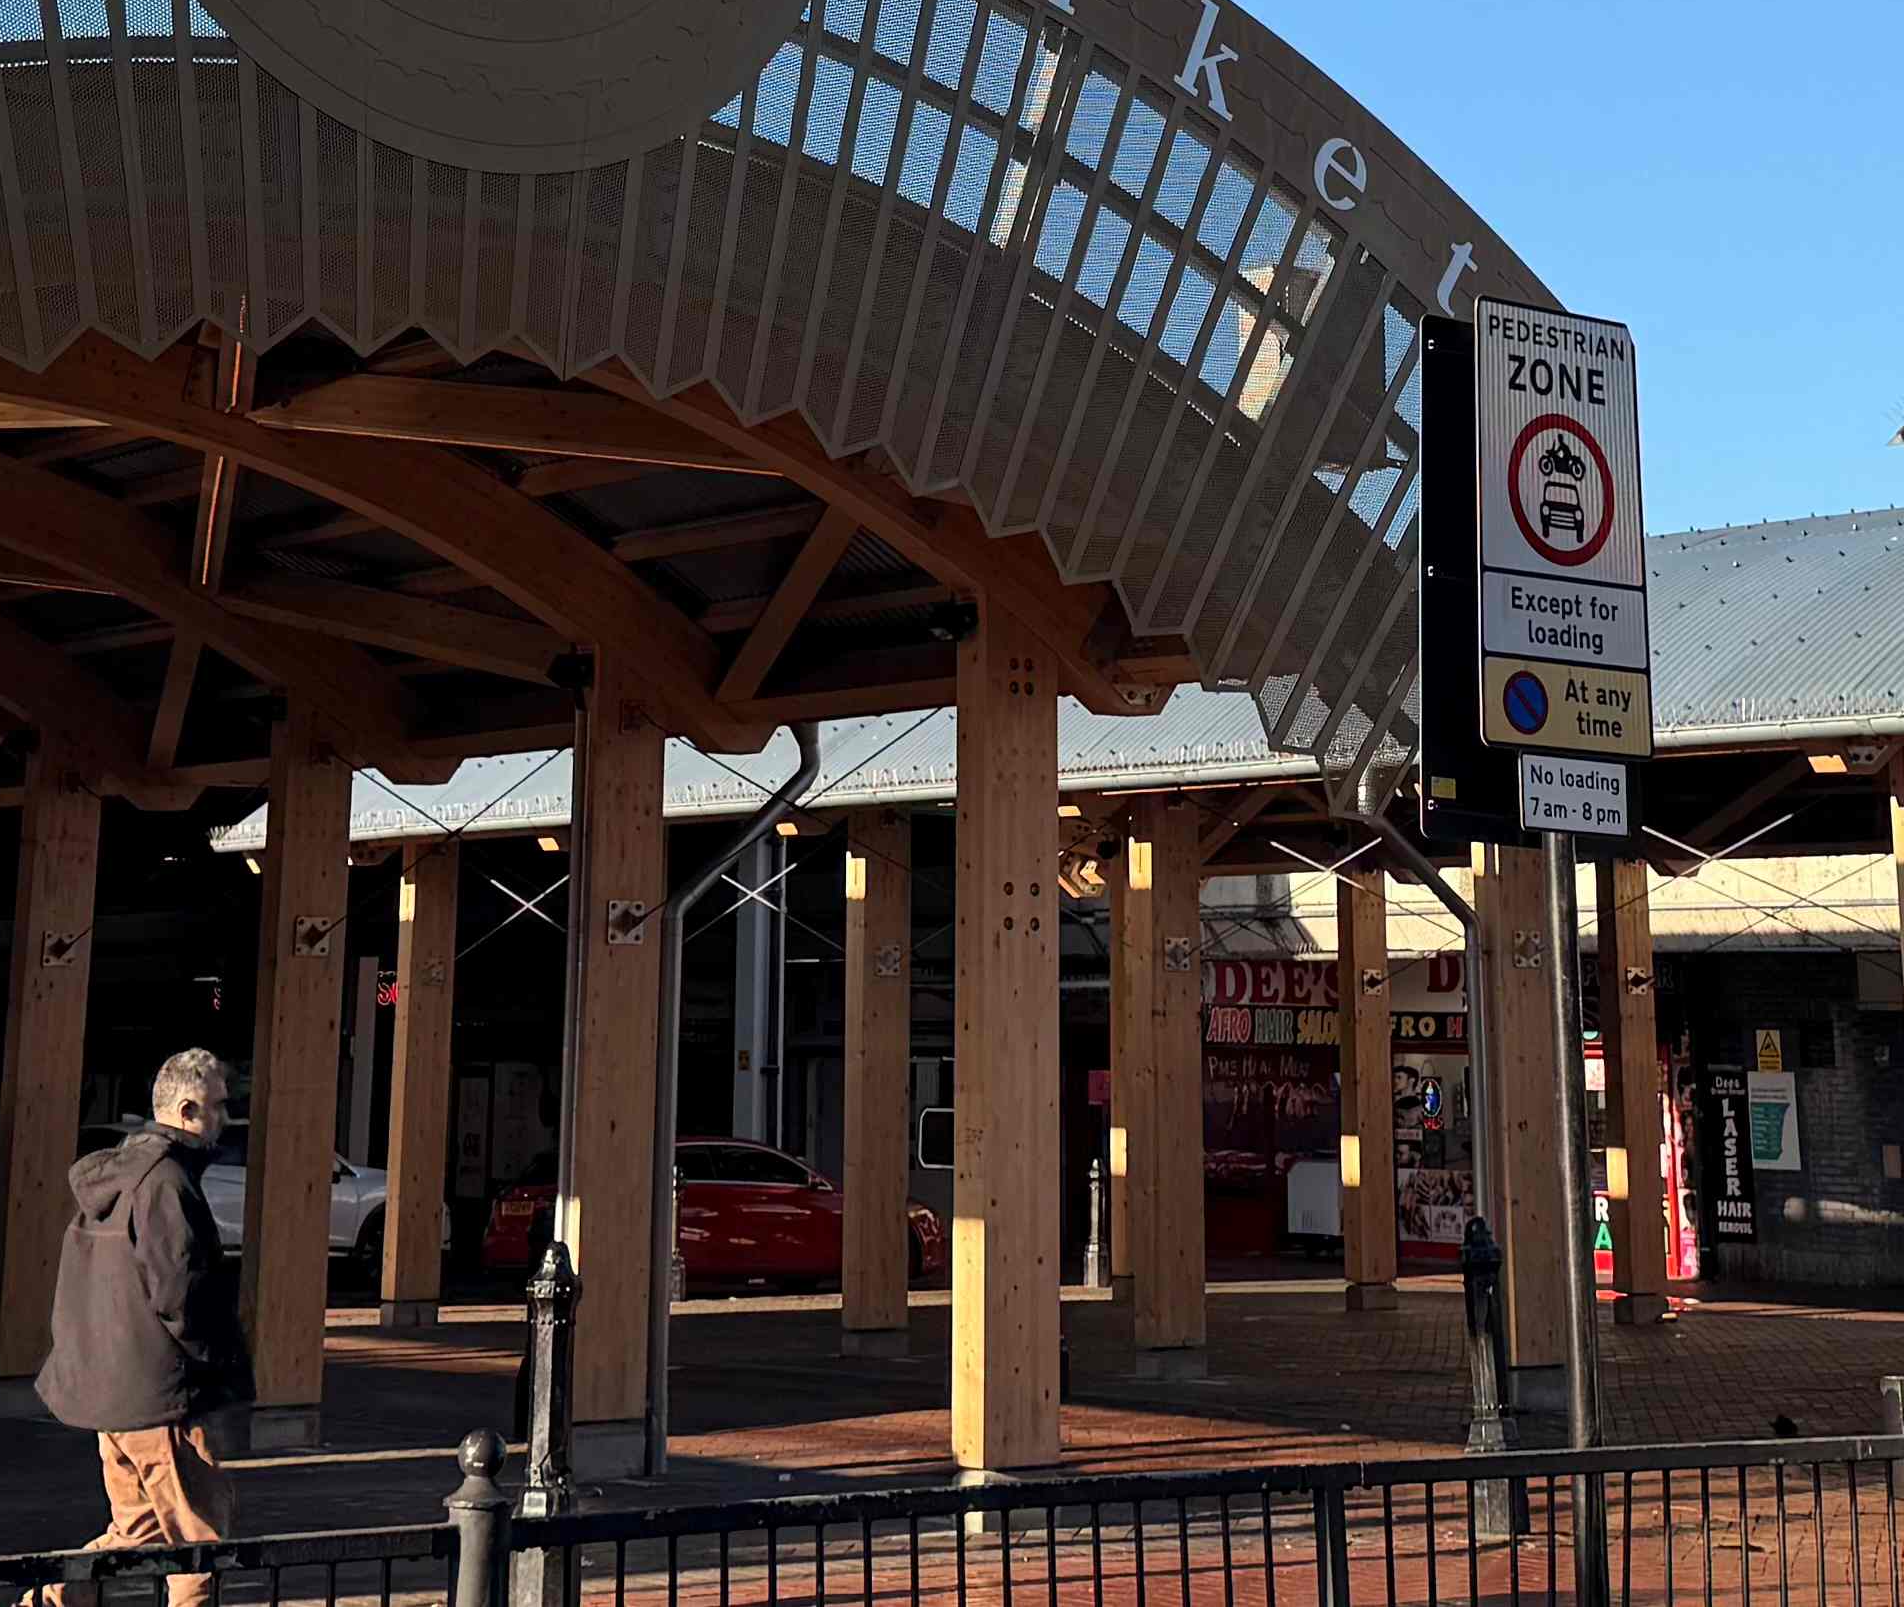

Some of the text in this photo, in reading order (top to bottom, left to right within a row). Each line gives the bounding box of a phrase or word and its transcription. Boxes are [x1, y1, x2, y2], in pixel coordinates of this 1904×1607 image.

[1489, 314, 1624, 362] PEDESTRIAN
[1508, 354, 1606, 406] ZONE
[1511, 586, 1618, 622] Except for
[1528, 620, 1604, 655] loading
[1565, 678, 1631, 713] At any
[1576, 713, 1623, 738] time
[1530, 764, 1620, 796] No loading
[1722, 1098, 1743, 1197] LASER
[1717, 1200, 1753, 1219] HAIR
